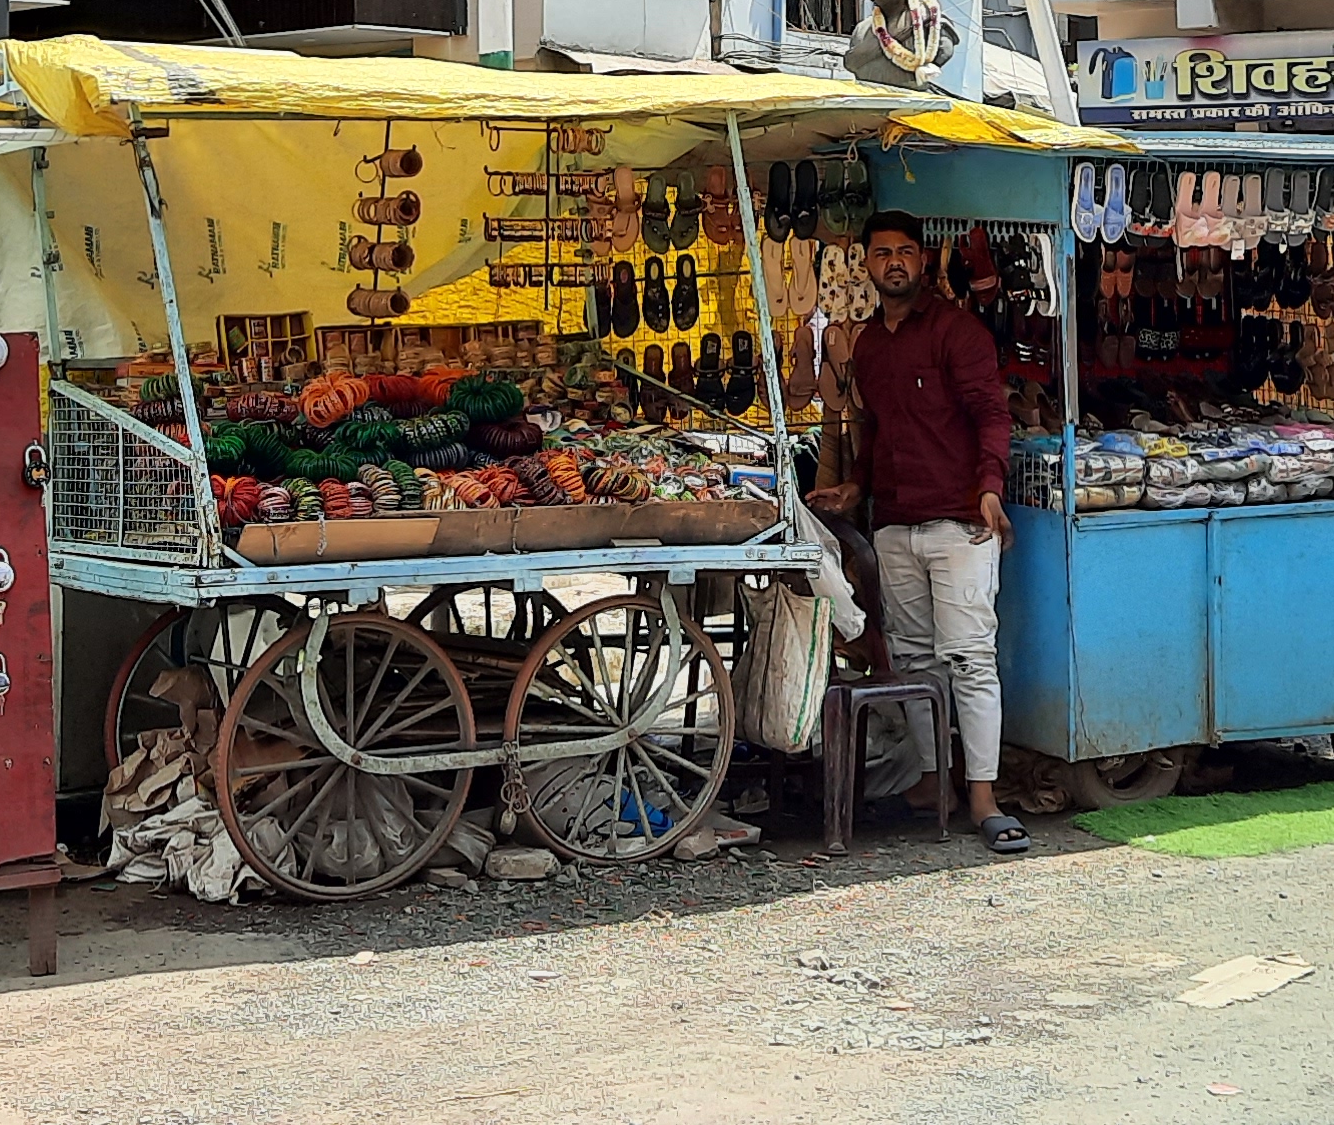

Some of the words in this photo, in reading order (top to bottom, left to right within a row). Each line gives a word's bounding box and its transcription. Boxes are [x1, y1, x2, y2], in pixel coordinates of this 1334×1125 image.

[1130, 107, 1187, 120] समस्त
[1190, 106, 1241, 120] प्रकार
[1244, 103, 1271, 118] की
